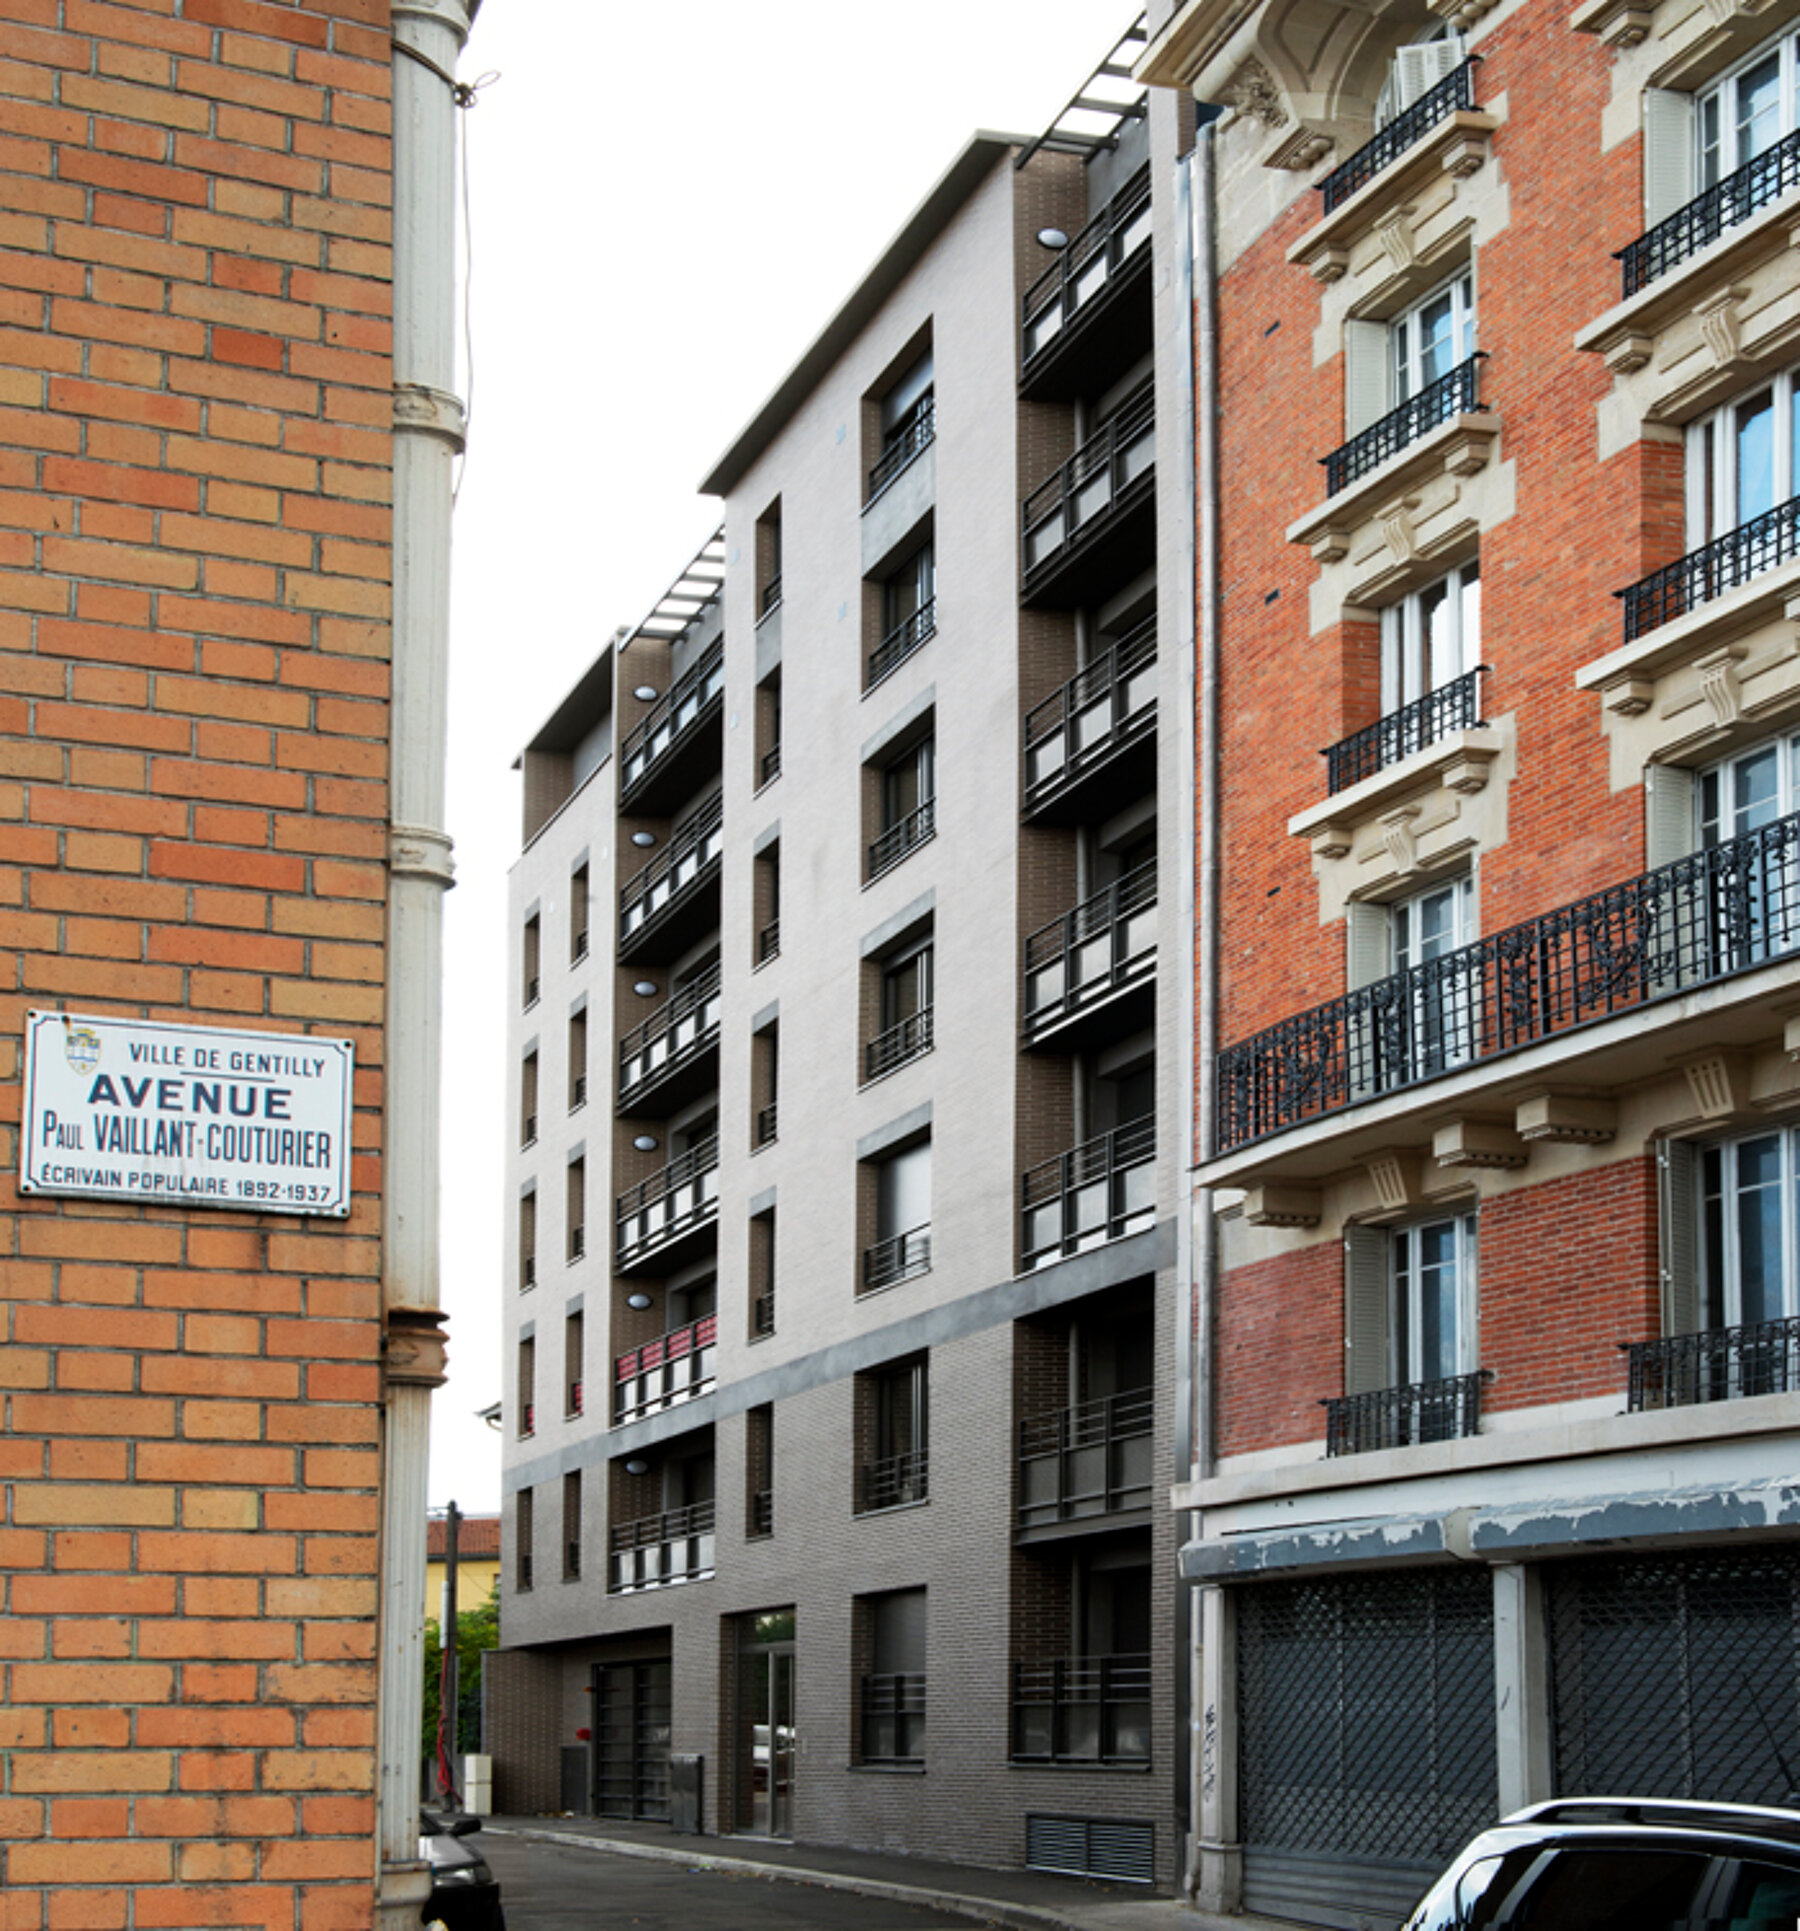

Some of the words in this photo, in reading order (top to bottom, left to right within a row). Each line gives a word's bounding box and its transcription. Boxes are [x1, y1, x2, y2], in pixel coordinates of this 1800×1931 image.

[129, 1043, 185, 1067] VILLE
[195, 1049, 220, 1069] DE
[231, 1051, 325, 1078] GENTILLY
[88, 1074, 293, 1120] AVENUE
[41, 1163, 122, 1187] ÉCRIVAIN
[128, 1174, 228, 1196] POPULAIRE
